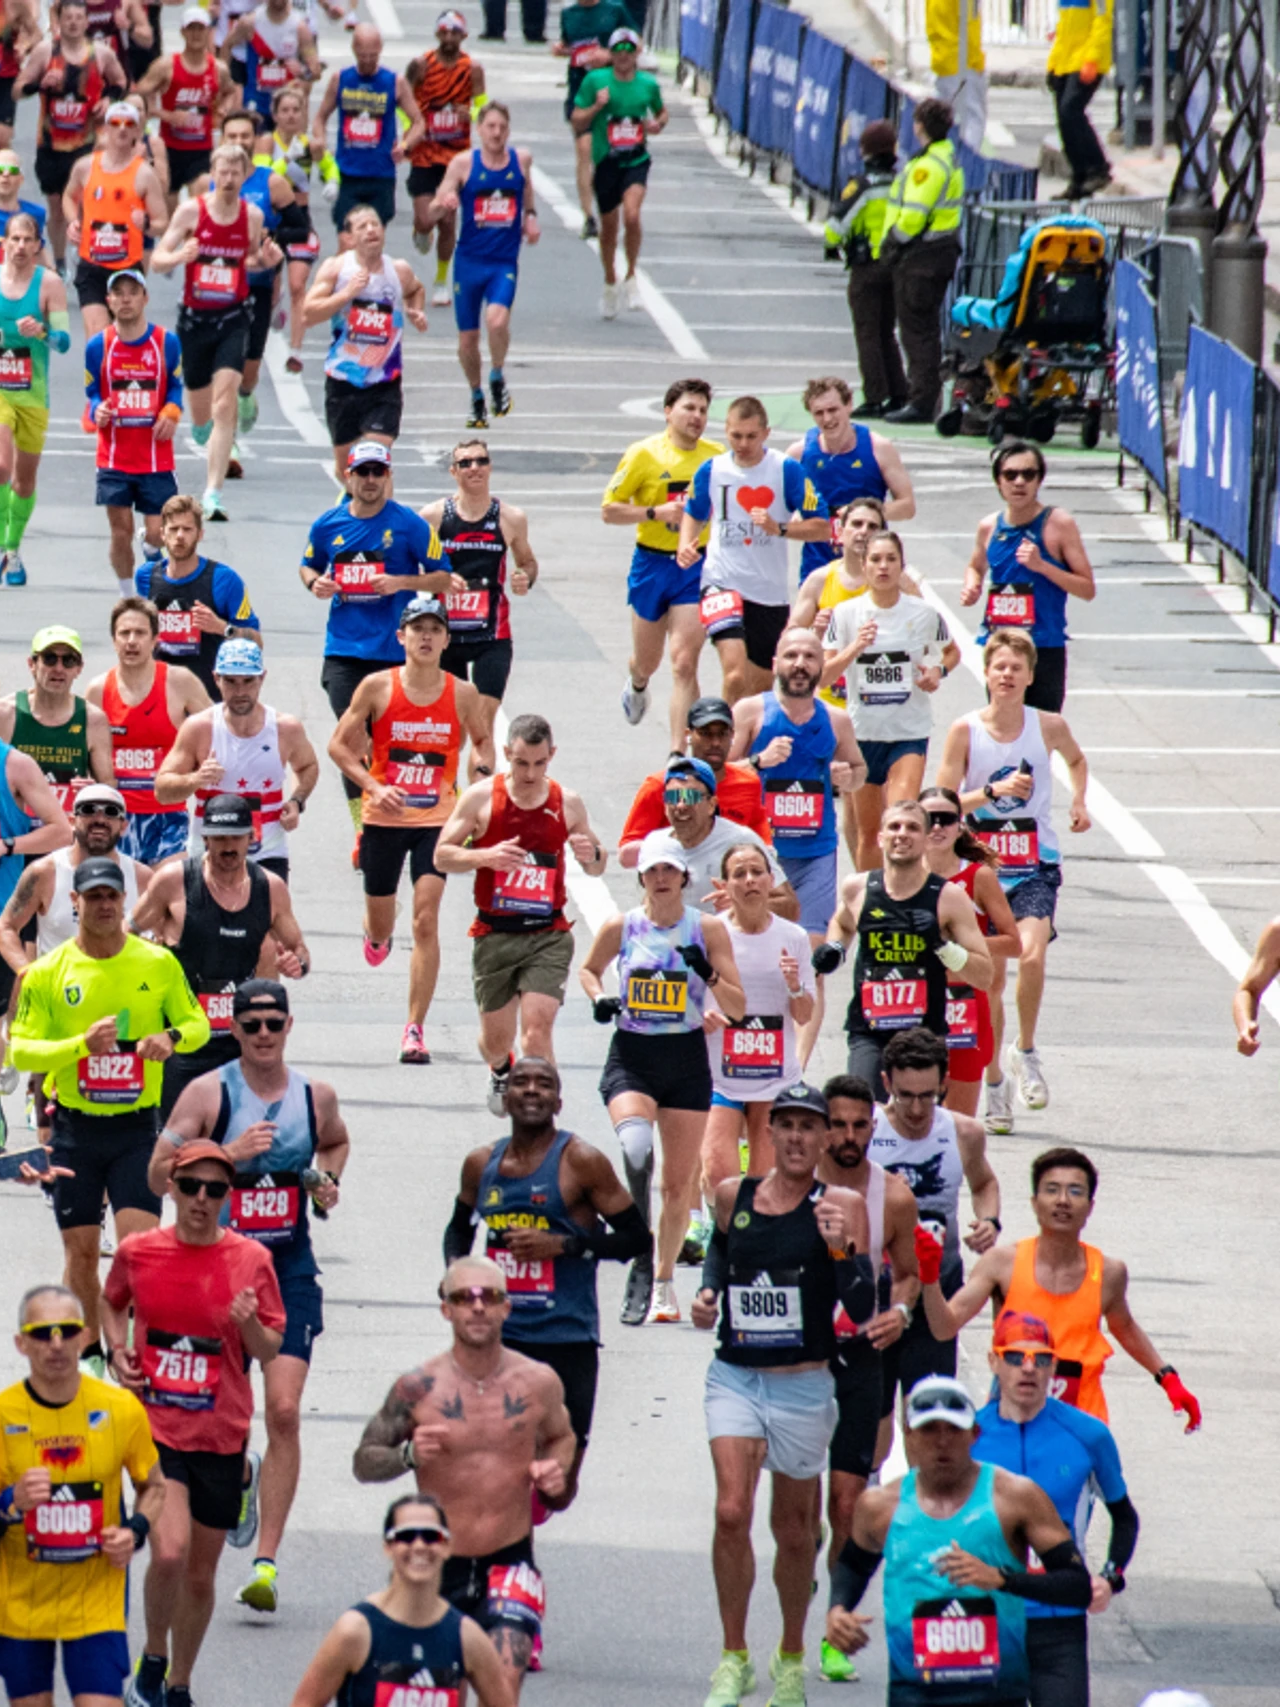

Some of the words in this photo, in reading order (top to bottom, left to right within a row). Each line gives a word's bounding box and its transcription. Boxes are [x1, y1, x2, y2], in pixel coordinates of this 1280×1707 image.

[775, 796, 814, 816] 6604
[869, 932, 925, 952] K-LIB
[876, 949, 917, 962] CREW
[632, 980, 681, 1006] KELLY
[873, 980, 916, 1006] 6177
[88, 1056, 134, 1080] 5922
[483, 1213, 550, 1231] ANGOLA
[740, 1290, 788, 1317] 9809
[926, 1619, 986, 1652] 6600
